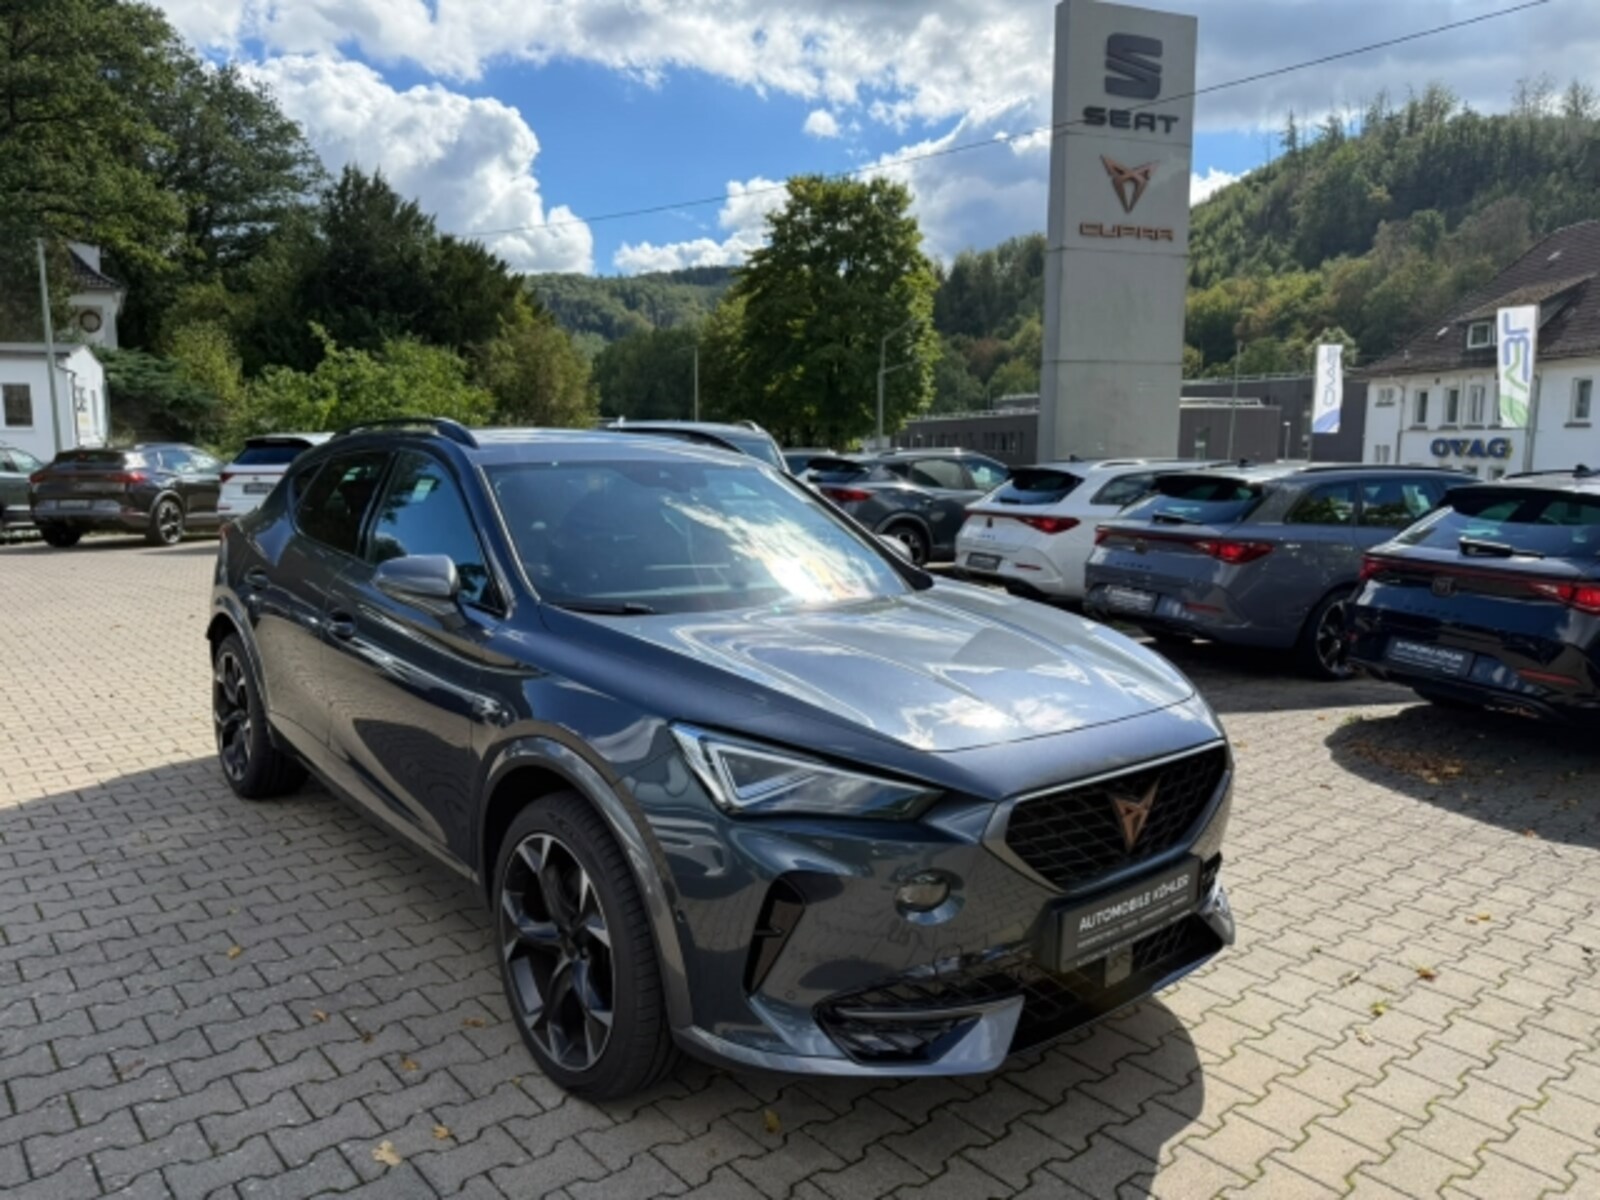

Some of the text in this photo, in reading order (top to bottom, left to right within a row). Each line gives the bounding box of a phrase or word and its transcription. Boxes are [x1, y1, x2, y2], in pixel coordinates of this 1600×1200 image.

[1083, 105, 1179, 134] SEAT
[1079, 222, 1174, 242] CUPRA
[1430, 437, 1512, 460] OVAG
[1079, 891, 1151, 932] AUTOMOBILE
